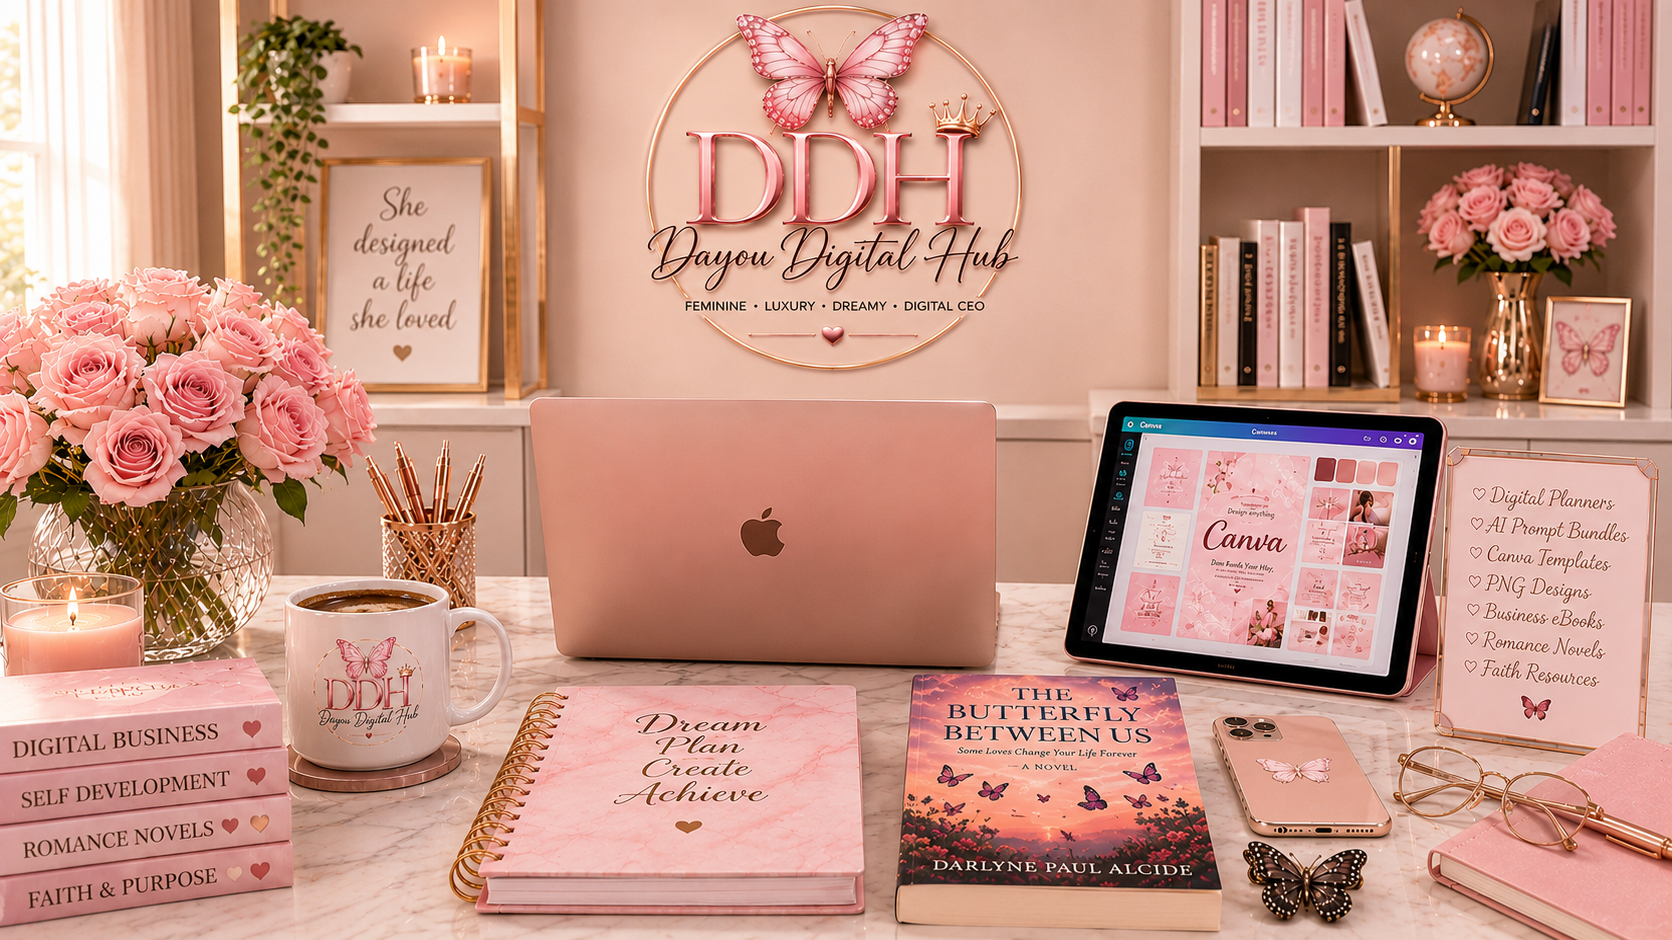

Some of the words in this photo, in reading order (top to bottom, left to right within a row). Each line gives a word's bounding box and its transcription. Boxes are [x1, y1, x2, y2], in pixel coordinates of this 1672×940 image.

[686, 131, 975, 225] DDH
[380, 186, 428, 221] She
[354, 223, 456, 266] designed
[647, 226, 774, 291] Dayou
[781, 226, 920, 291] Digital
[924, 226, 1018, 283] Hub
[373, 276, 390, 291] a
[397, 262, 436, 302] life
[350, 298, 390, 331] she
[397, 299, 457, 330] loved
[685, 301, 747, 312] FEMININE
[765, 301, 816, 312] LUXURY
[832, 301, 887, 312] DREAMY
[904, 301, 953, 312] DIGITAL
[958, 301, 985, 312] CEO
[1489, 486, 1545, 511] Digital
[1549, 489, 1615, 510] Planners
[1203, 520, 1287, 552] Canva
[1485, 516, 1508, 535] AI
[1511, 518, 1564, 542] Prompt
[1567, 521, 1629, 542] Bundles
[1487, 545, 1534, 565] Canva
[1538, 549, 1611, 573] Templates
[1485, 574, 1525, 598] PNG
[1530, 578, 1592, 604] Designs
[1483, 603, 1548, 624] Business
[1552, 609, 1605, 629] eBooks
[1482, 631, 1550, 653] Romance
[1553, 638, 1605, 660] Novels
[1481, 660, 1522, 679] Faith
[1526, 663, 1599, 687] Resources
[324, 676, 412, 711] DDH
[1012, 688, 1073, 701] THE
[354, 710, 393, 730] Digital
[396, 705, 419, 725] Hub
[636, 713, 767, 734] Dream
[947, 705, 1141, 722] BUTTERFLY
[13, 734, 105, 758] DIGITAL
[112, 723, 218, 749] BUSINESS
[656, 735, 744, 755] Plan
[944, 725, 1100, 743] BETWEEN
[1110, 728, 1152, 744] US
[958, 747, 983, 755] Some
[986, 747, 1012, 755] Loves
[1015, 748, 1050, 758] Change
[1054, 749, 1076, 757] Your
[1079, 749, 1096, 759] Life
[1100, 750, 1137, 758] Forever
[642, 758, 752, 777] Create
[21, 788, 69, 808] SELF
[76, 771, 230, 802] DEVELOPMENT
[614, 781, 769, 806] Achieve
[23, 830, 128, 858] ROMANCE
[134, 821, 214, 845] NOVELS
[933, 860, 1037, 873] DARLYNE
[1045, 861, 1102, 875] PAUL
[1108, 863, 1192, 876] ALCIDE
[29, 884, 92, 908] FAITH
[100, 882, 116, 898] &
[122, 868, 217, 895] PURPOSE
